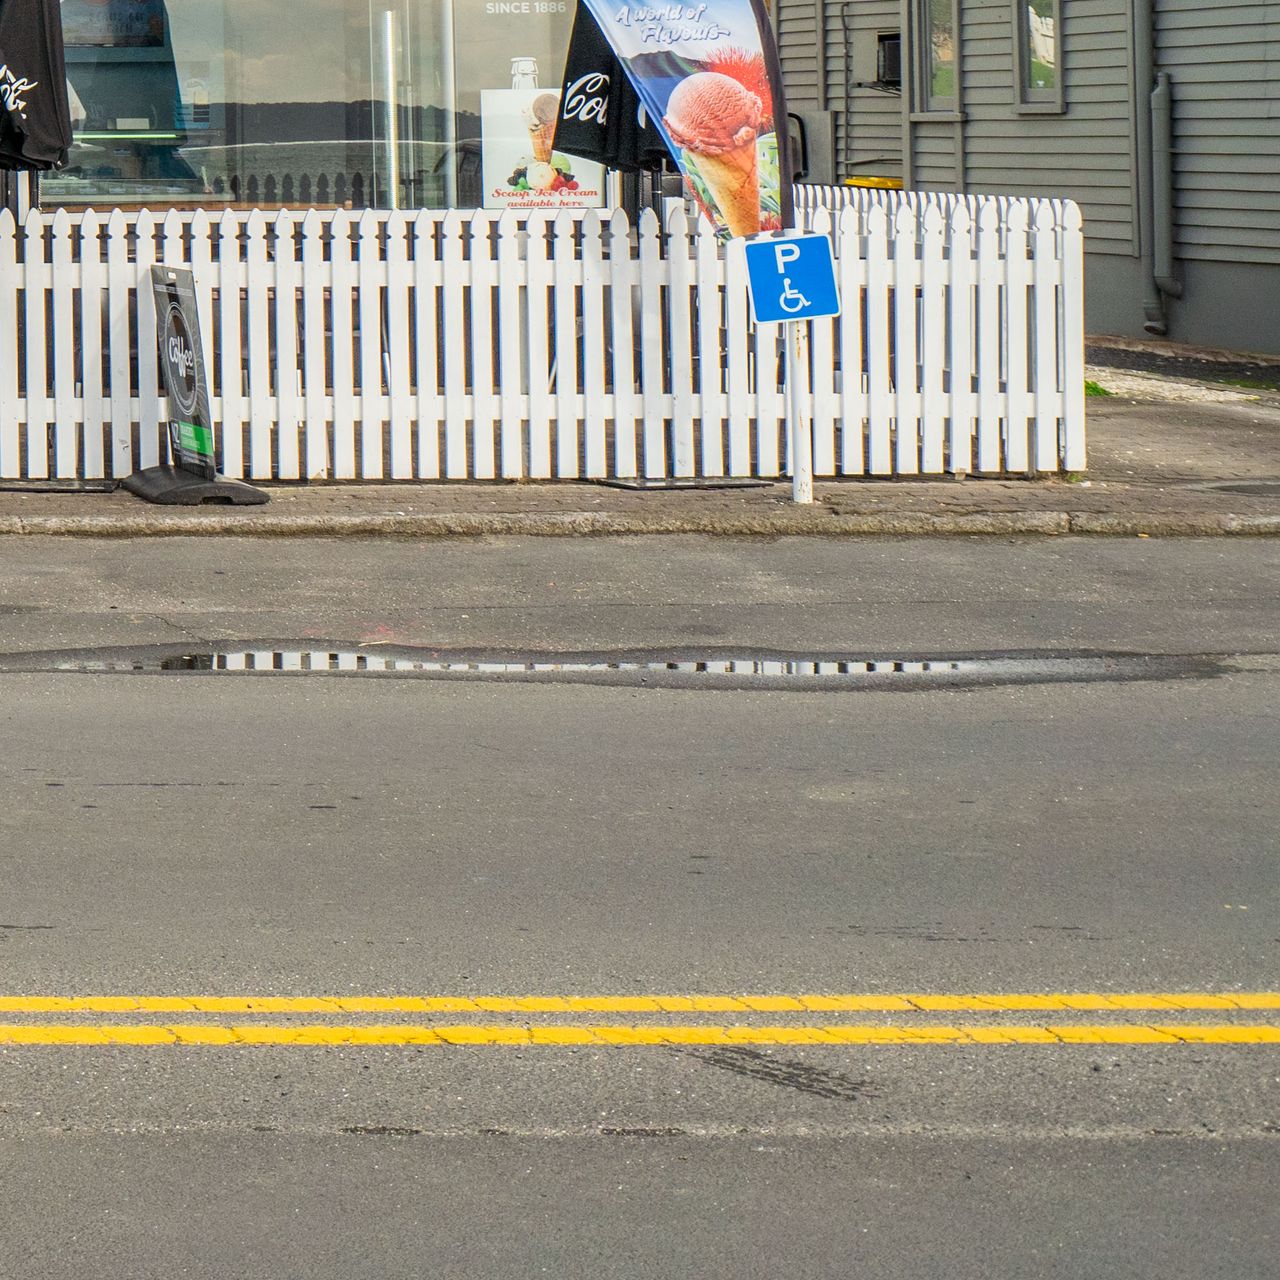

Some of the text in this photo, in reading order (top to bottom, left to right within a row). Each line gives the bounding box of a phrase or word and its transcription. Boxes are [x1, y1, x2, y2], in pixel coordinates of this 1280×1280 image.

[486, 1, 566, 14] SINCE 1886
[616, 5, 631, 27] A
[686, 3, 708, 23] of
[640, 22, 731, 45] Flavours
[492, 188, 530, 200] Scoop
[558, 187, 598, 197] Cream
[507, 199, 584, 208] available here
[774, 243, 801, 274] P
[168, 335, 194, 378] Coffee
